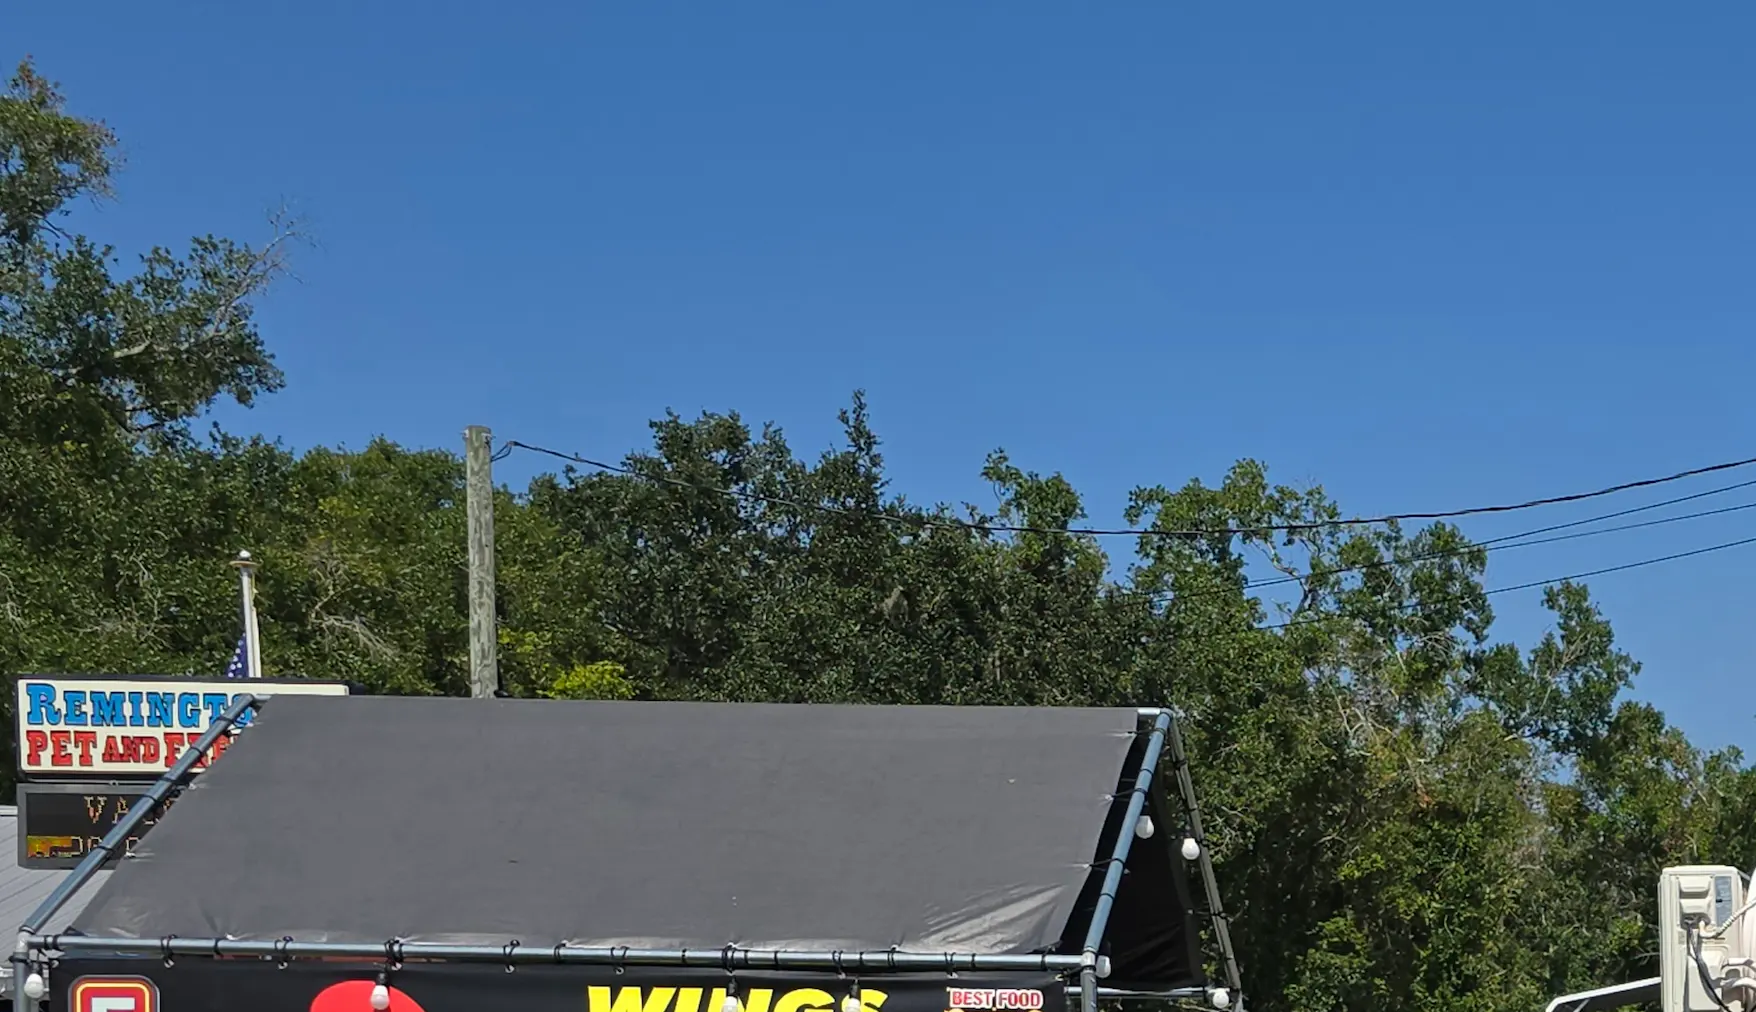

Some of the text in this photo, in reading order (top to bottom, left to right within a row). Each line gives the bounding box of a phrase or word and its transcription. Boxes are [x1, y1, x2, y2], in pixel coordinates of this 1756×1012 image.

[26, 730, 96, 766] PET
[102, 736, 160, 763] AND
[951, 990, 1042, 1008] BEST FOOD
